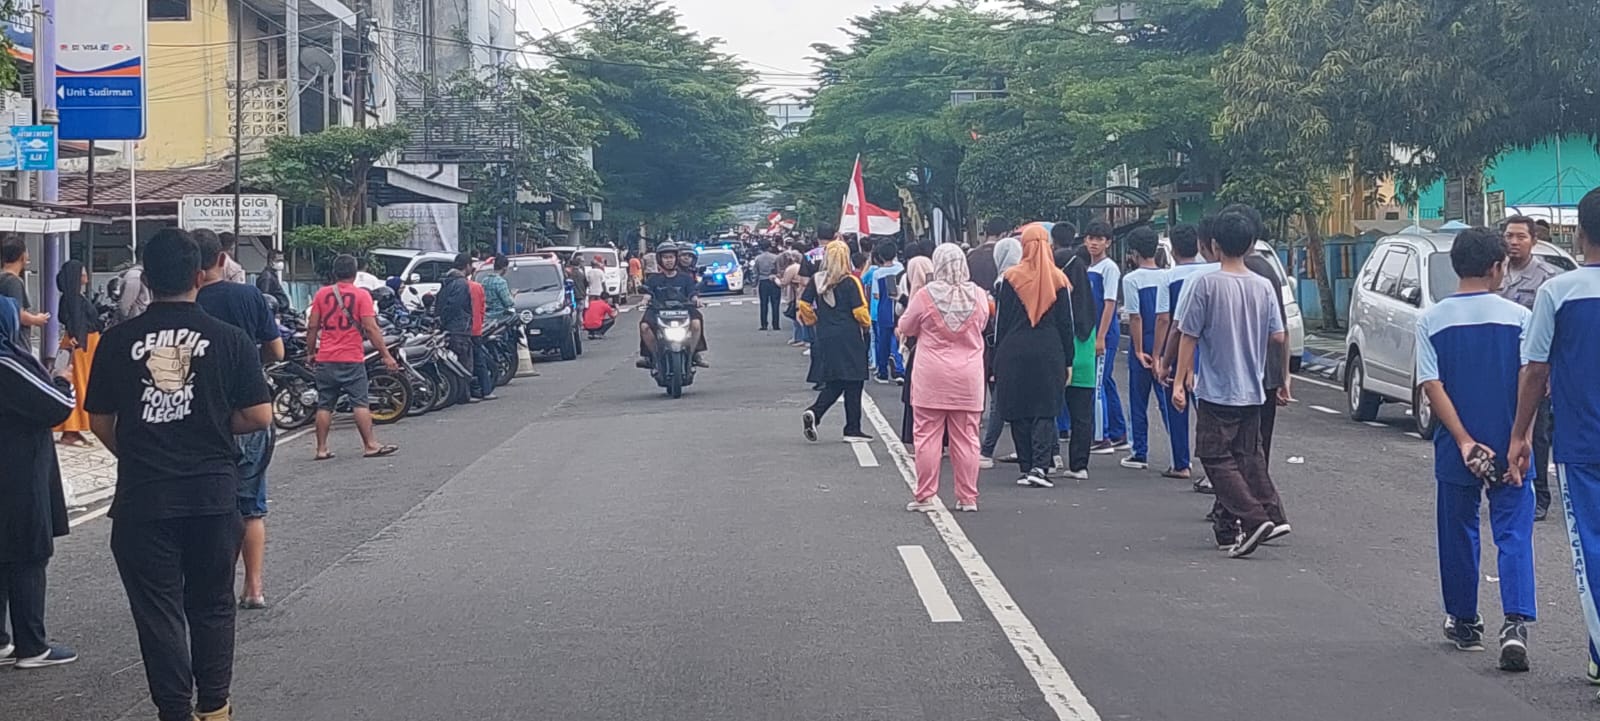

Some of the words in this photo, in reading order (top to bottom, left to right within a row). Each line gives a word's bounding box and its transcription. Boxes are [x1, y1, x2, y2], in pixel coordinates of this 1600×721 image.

[66, 88, 86, 96] Unit
[88, 88, 133, 96] Sudirman
[242, 198, 268, 207] GIGI
[211, 209, 250, 217] CHAYTI
[131, 328, 210, 361] GEMPUR
[140, 384, 194, 409] ROKOK
[142, 401, 192, 424] ILEGAL
